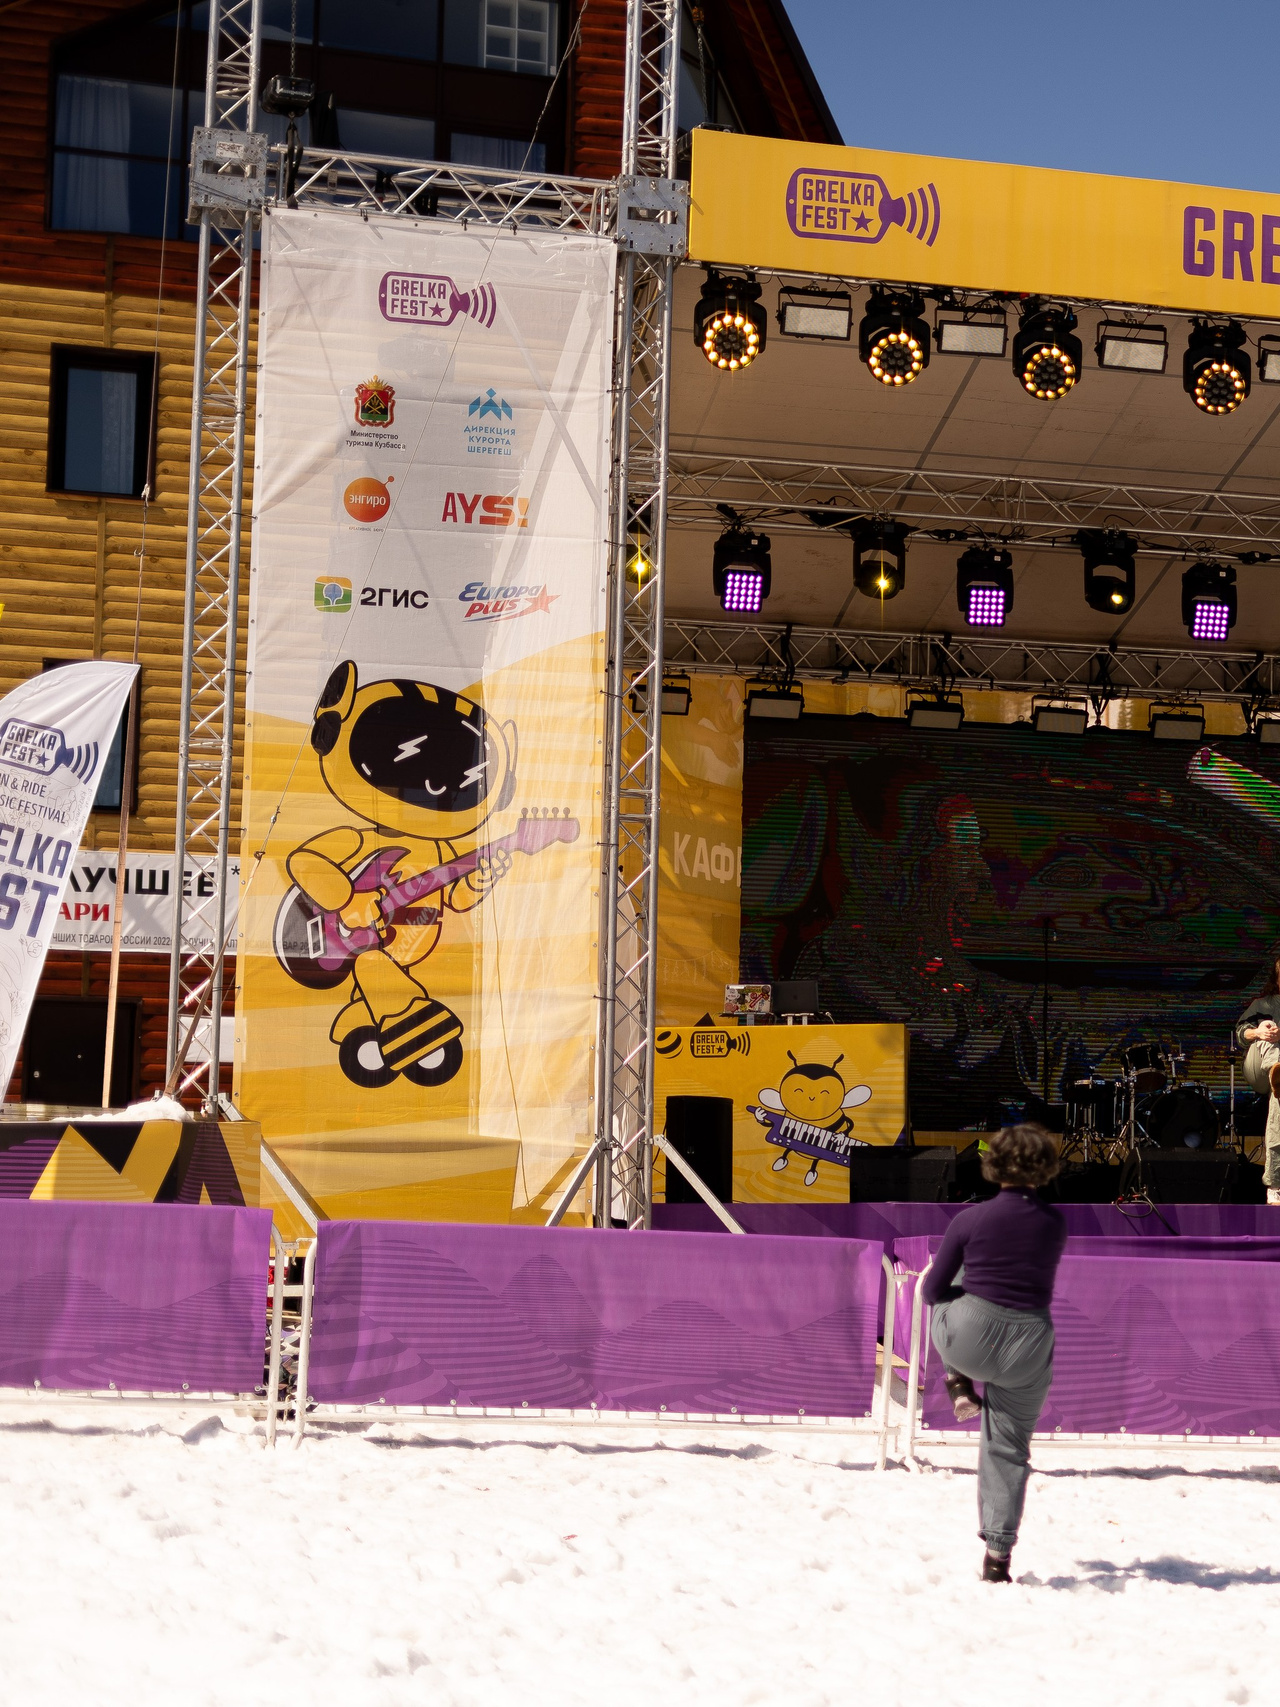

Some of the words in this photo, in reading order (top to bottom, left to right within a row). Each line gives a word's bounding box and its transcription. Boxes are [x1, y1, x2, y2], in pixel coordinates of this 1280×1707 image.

[802, 178, 875, 207] GRELKA
[801, 205, 851, 231] FEST
[391, 279, 447, 299] GRELKA
[391, 298, 428, 316] FEST
[351, 430, 399, 440] Министерство
[463, 425, 516, 436] ДИРЕКЦИЯ
[468, 435, 511, 446] КУРОРТА
[374, 441, 406, 450] Кузбасса
[467, 445, 512, 456] ШЕРЕГЕШ
[349, 494, 387, 507] энгиро
[441, 492, 530, 528] AYS!
[360, 587, 429, 610] 2ГИС
[458, 581, 542, 602] Europa
[7, 724, 57, 751] GRELKA
[2, 742, 36, 764] FEST
[11, 778, 18, 790] &
[21, 780, 47, 798] RIDE
[18, 799, 66, 824] FESTIVAL
[674, 831, 742, 888] КАФ
[696, 1034, 725, 1044] GRELKA
[696, 1045, 715, 1054] FEST
